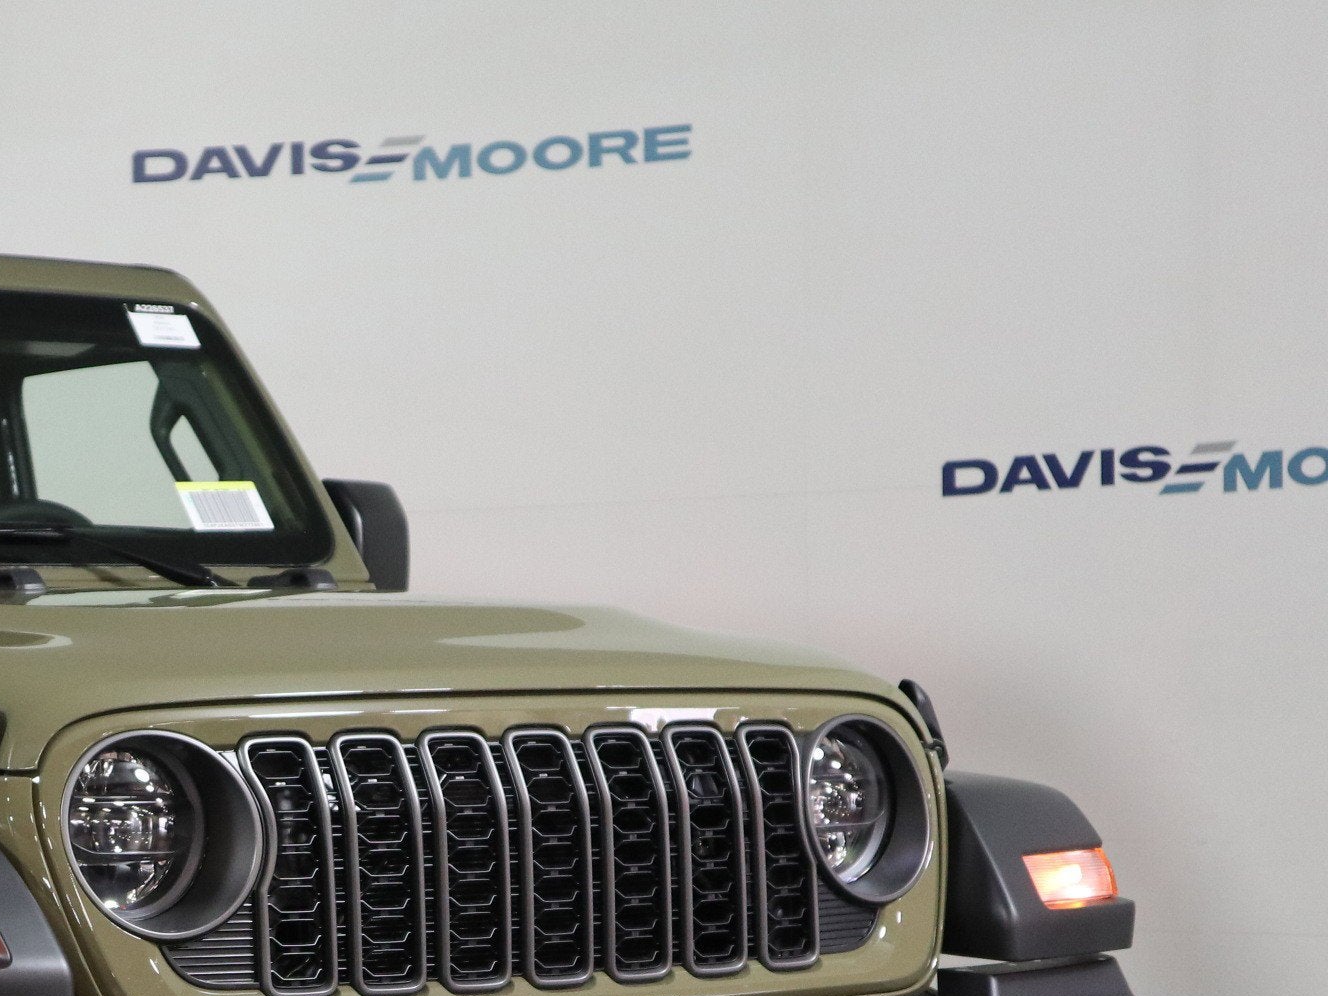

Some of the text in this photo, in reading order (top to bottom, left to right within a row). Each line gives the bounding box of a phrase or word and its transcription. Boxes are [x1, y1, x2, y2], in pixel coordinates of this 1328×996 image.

[131, 123, 693, 184] DAVIS MOORE
[941, 445, 1328, 498] DAVIS MO
